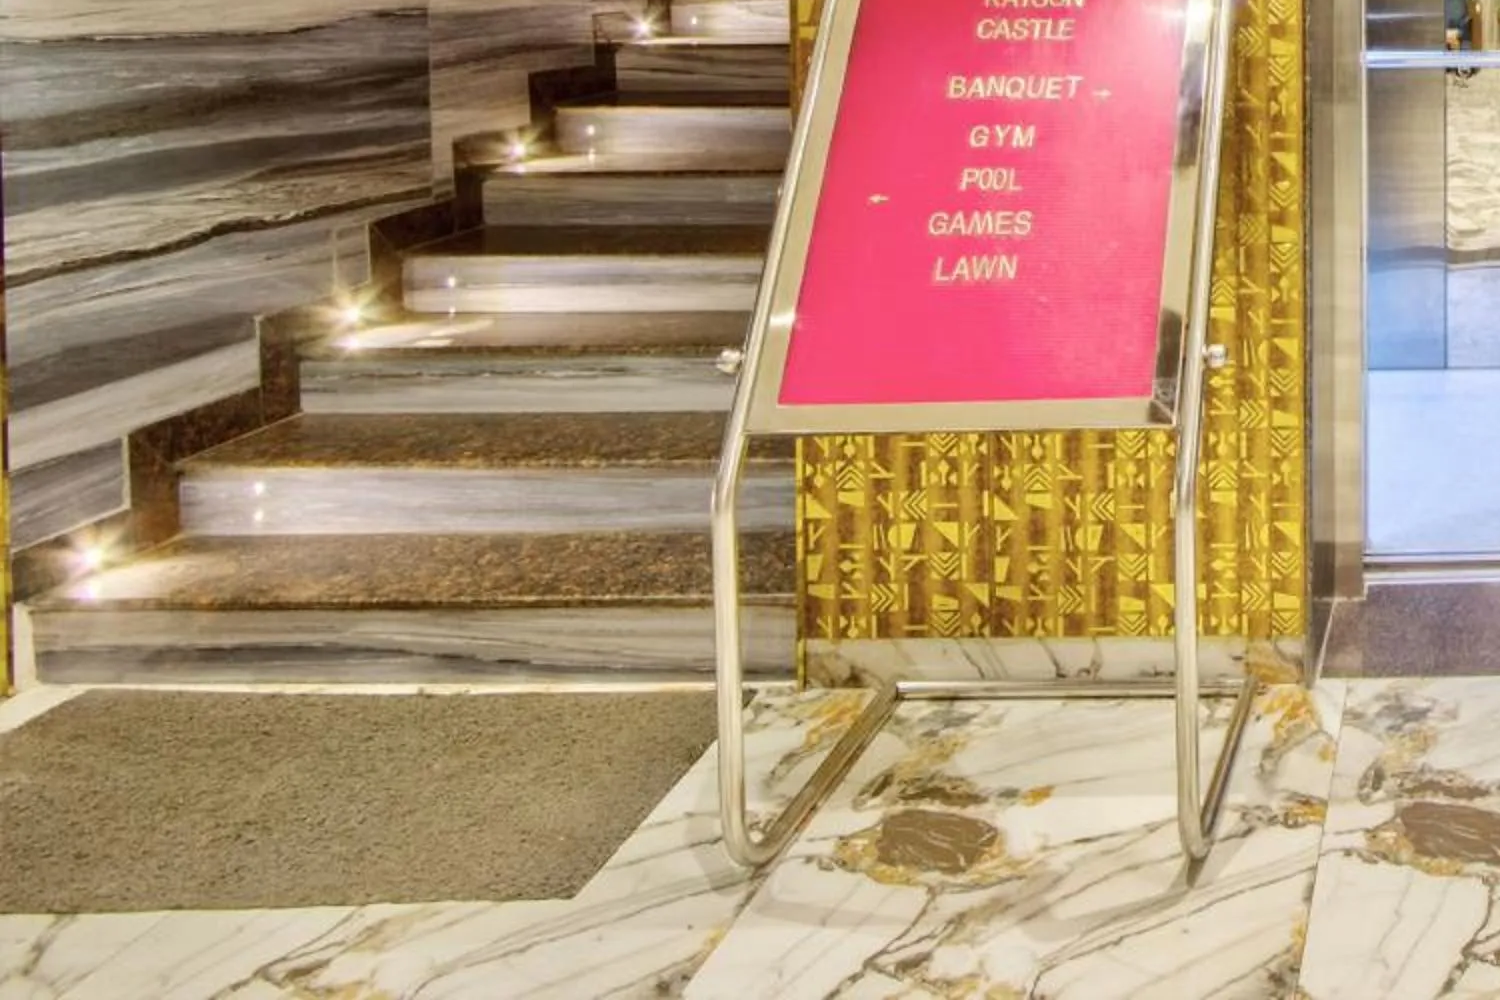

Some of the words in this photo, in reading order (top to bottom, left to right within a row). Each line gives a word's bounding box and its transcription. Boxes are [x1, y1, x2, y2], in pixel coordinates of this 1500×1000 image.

[976, 18, 1076, 41] CASTLE
[948, 75, 1084, 99] BANQUET
[969, 125, 1036, 148] GYM
[960, 168, 1024, 191] POOL
[928, 210, 1033, 236] GAMES
[934, 254, 1019, 282] LAWN
